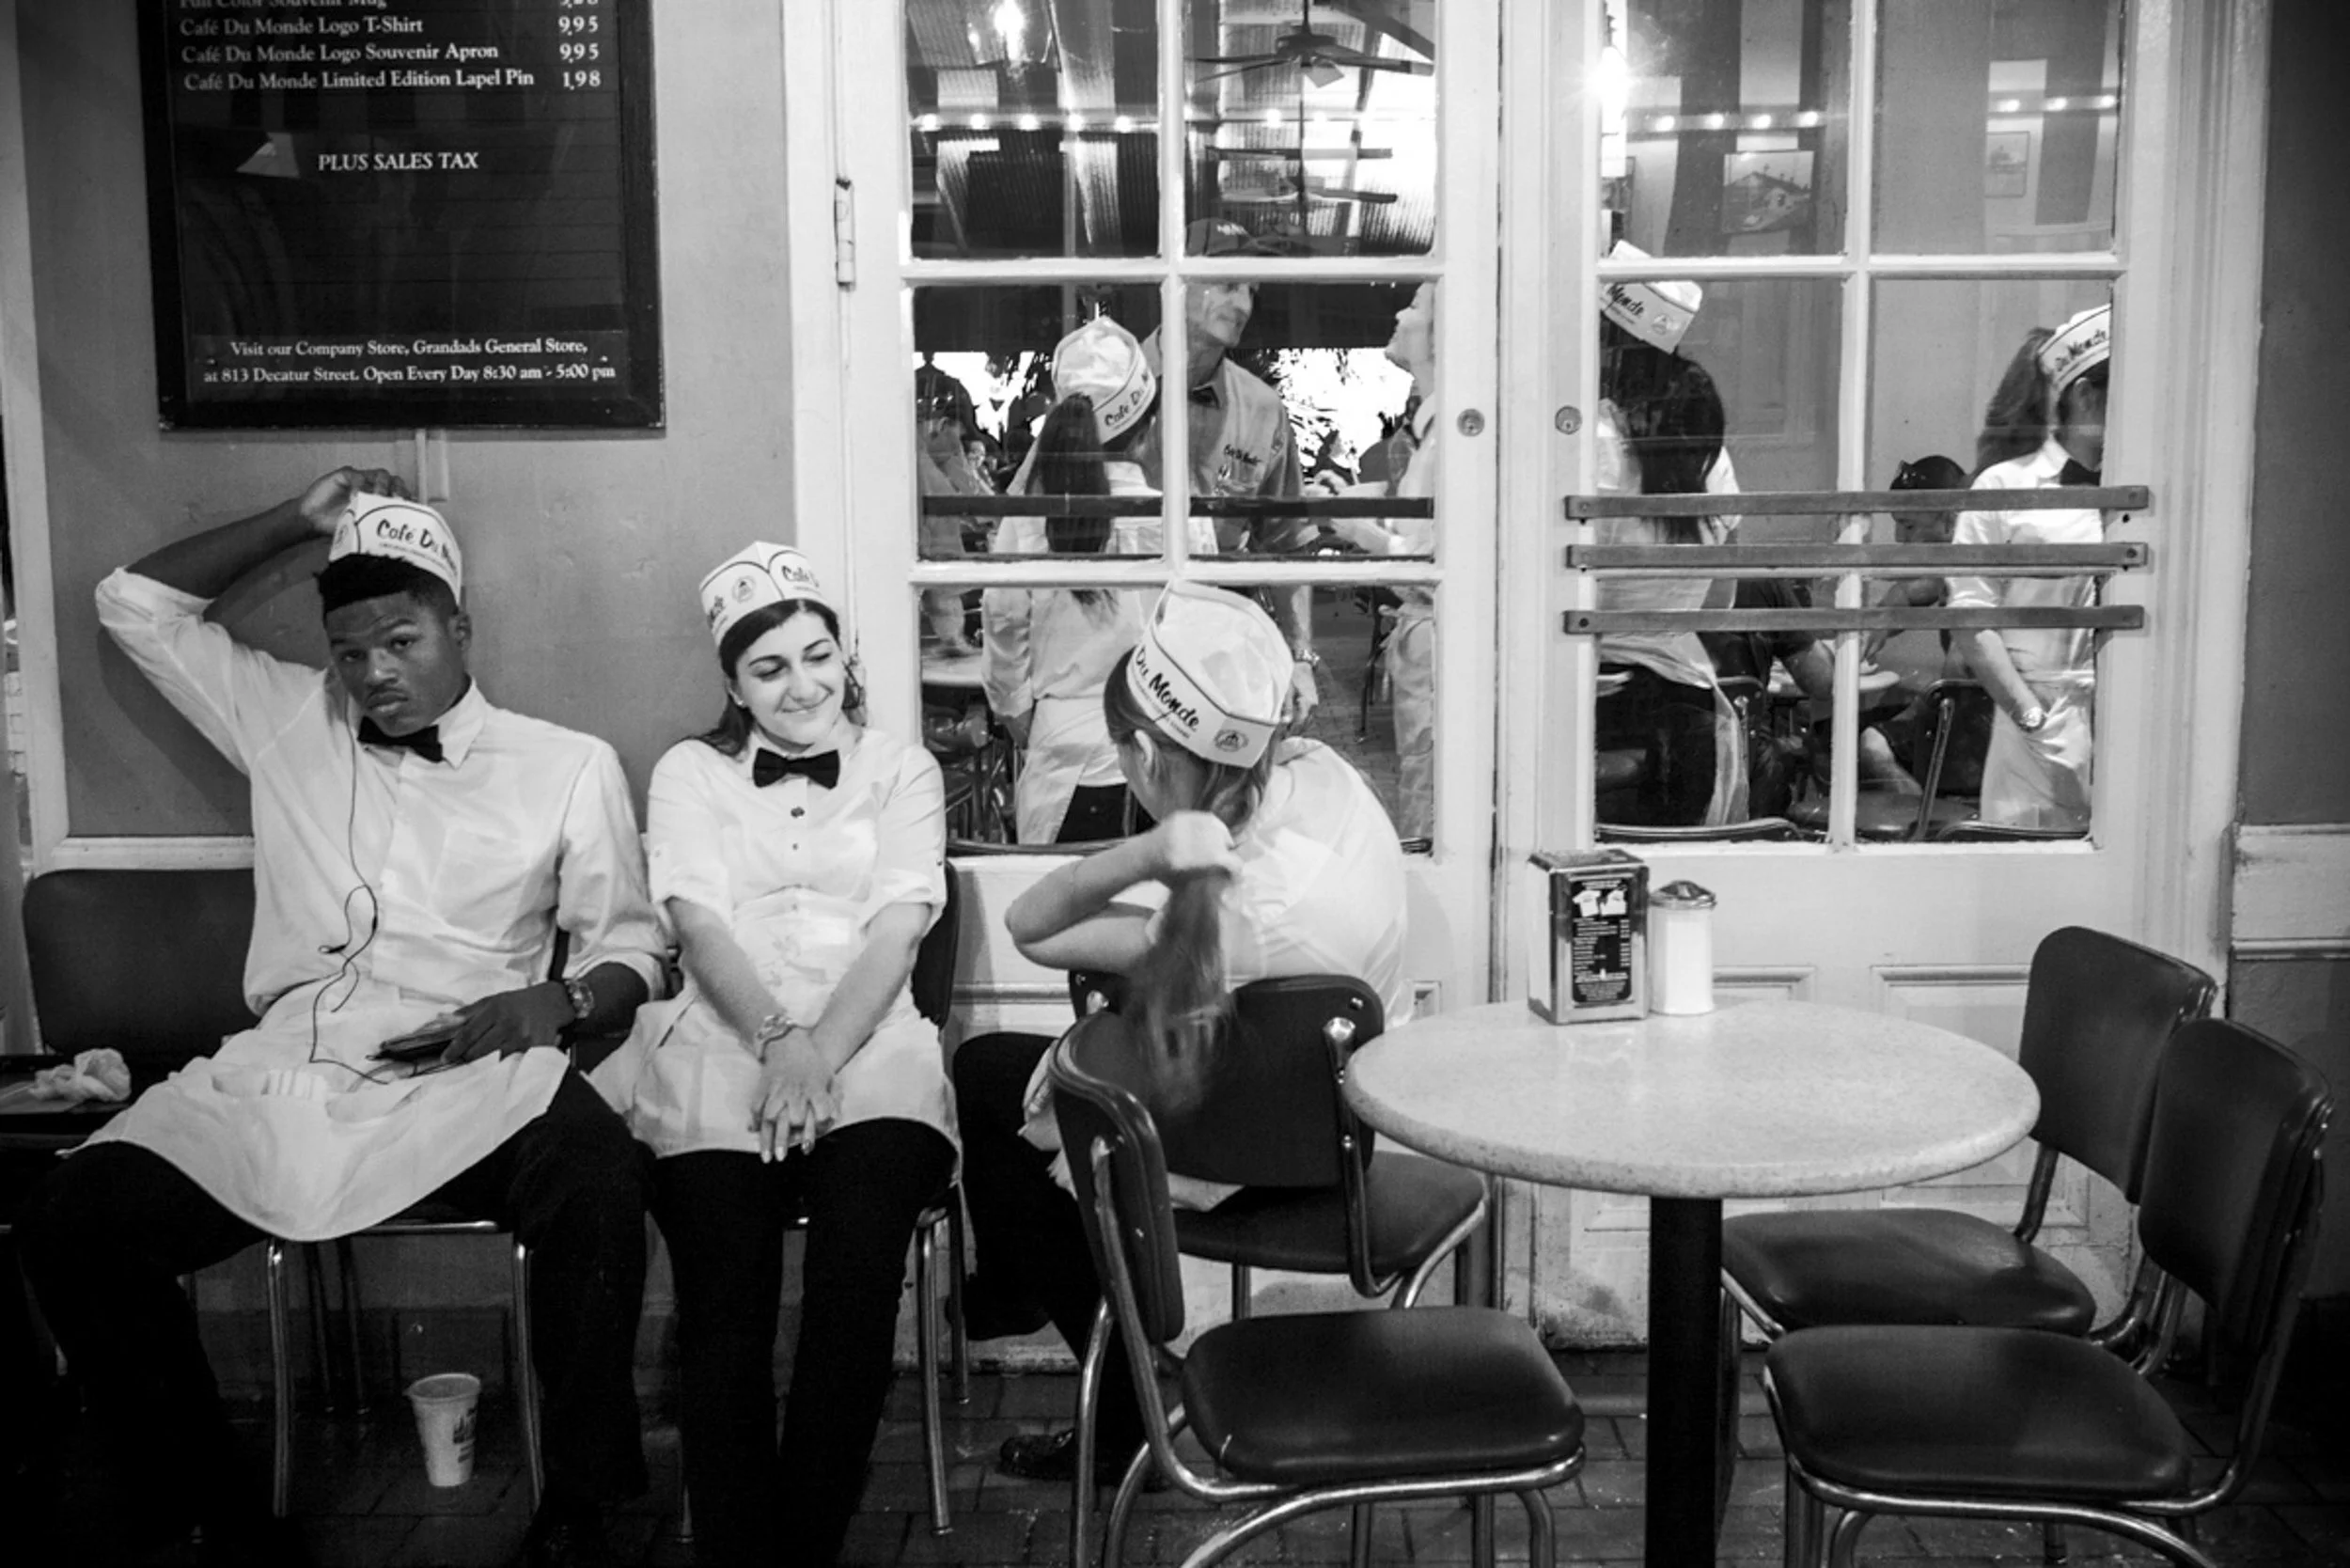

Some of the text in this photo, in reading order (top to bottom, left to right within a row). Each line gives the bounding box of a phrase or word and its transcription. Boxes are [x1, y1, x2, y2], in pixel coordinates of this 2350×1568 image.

[180, 15, 424, 38] Café Du Monde Logo T-Shirt
[181, 42, 499, 64] Café Du Monde Logo Souvenir Apron
[184, 68, 535, 90] Café Du Monde Limited Edition Lapel Pin
[318, 151, 479, 171] PLUS SALES TAX
[230, 337, 588, 358] Visit our Company Store, Grandads General Store,
[204, 371, 218, 383] at
[221, 368, 249, 383] 813
[253, 367, 310, 383] Decatur
[313, 366, 359, 382] Street.
[363, 365, 403, 384] Open
[406, 365, 447, 383] Every
[449, 364, 480, 383] Day
[482, 365, 517, 380] 8:30
[520, 368, 542, 380] am
[556, 364, 589, 380] 5:00
[591, 366, 617, 383] pm
[1148, 672, 1200, 734] Monde
